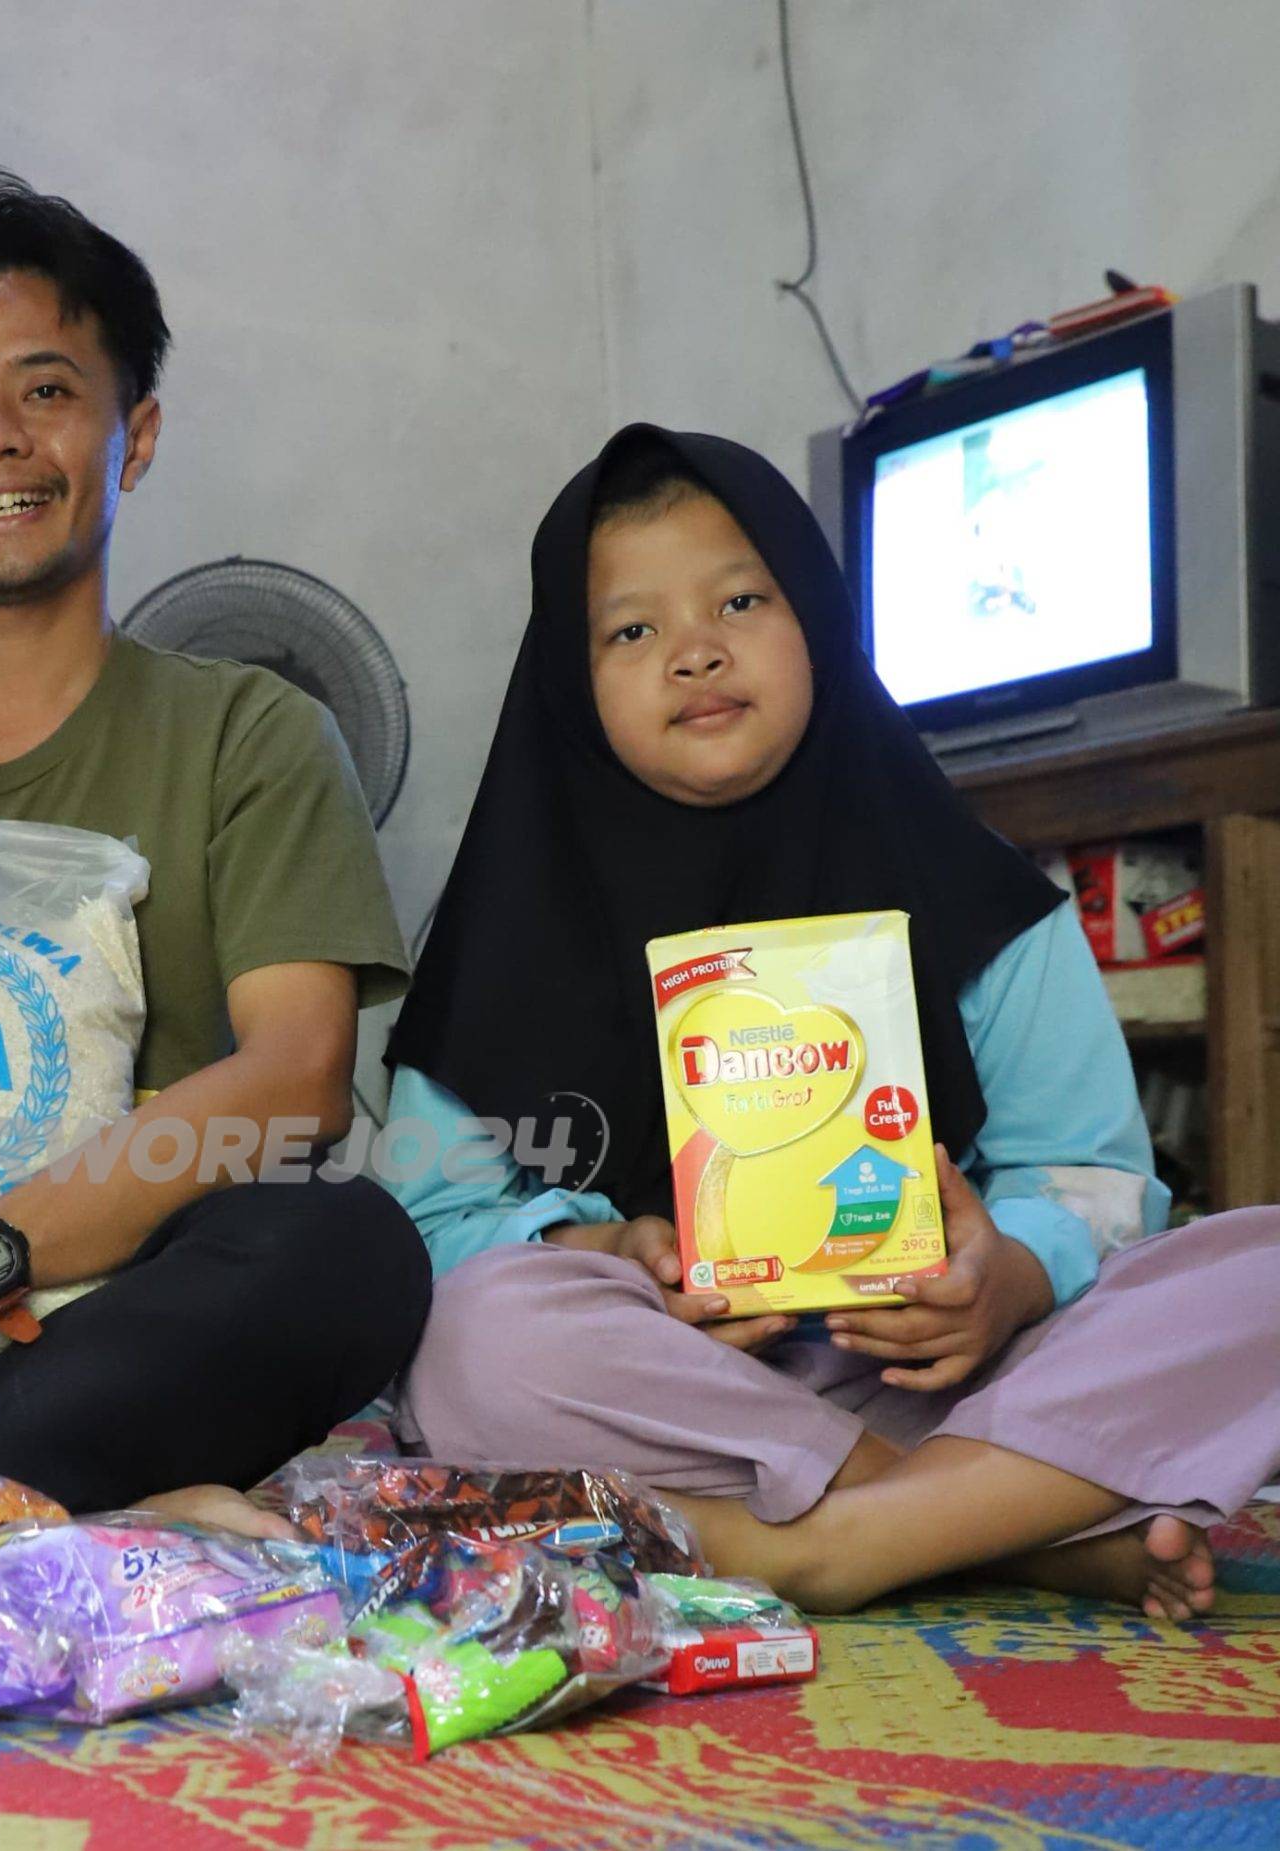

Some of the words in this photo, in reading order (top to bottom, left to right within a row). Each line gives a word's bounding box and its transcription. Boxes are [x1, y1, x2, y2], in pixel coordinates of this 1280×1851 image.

[661, 972, 690, 991] HIGH
[692, 958, 738, 978] PROTEIN
[869, 1111, 912, 1126] Cream
[901, 1238, 928, 1252] 390
[932, 1239, 941, 1252] g
